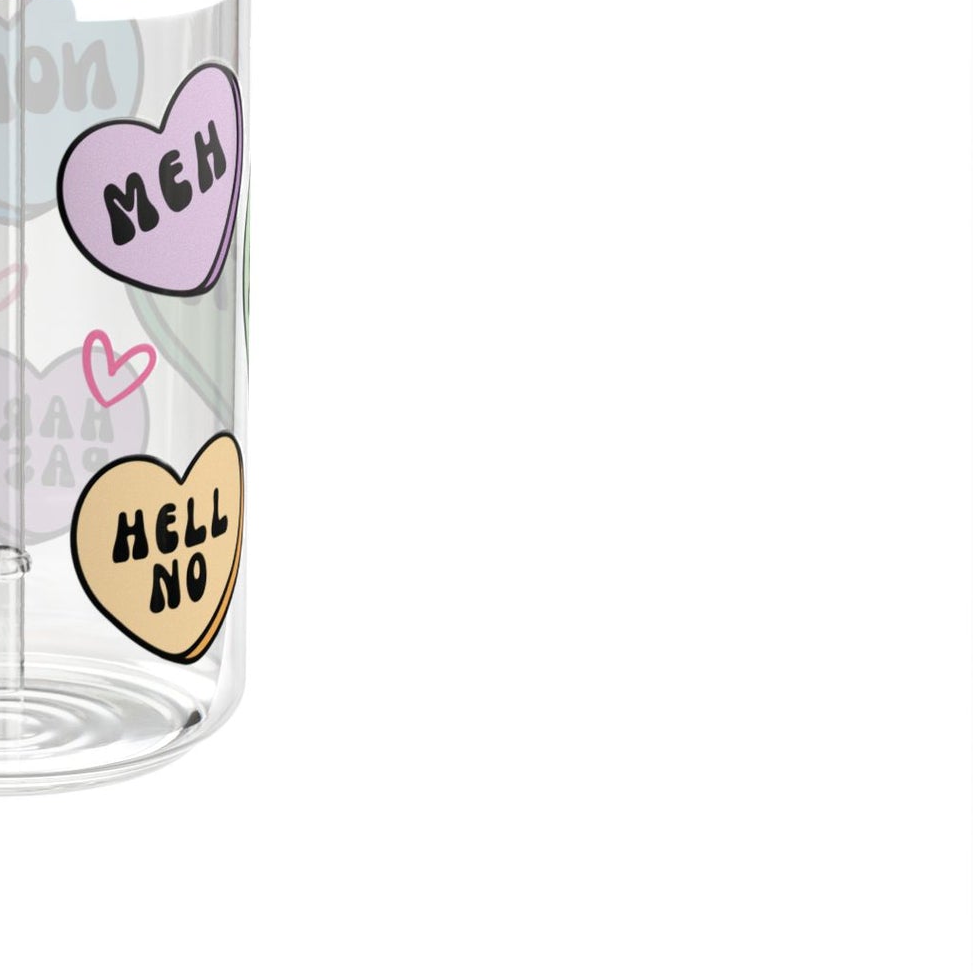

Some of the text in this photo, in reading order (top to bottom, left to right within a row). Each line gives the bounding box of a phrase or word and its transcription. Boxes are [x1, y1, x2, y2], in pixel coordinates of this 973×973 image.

[103, 120, 227, 246] MEH
[112, 487, 229, 564] HELL
[149, 551, 207, 614] NO
